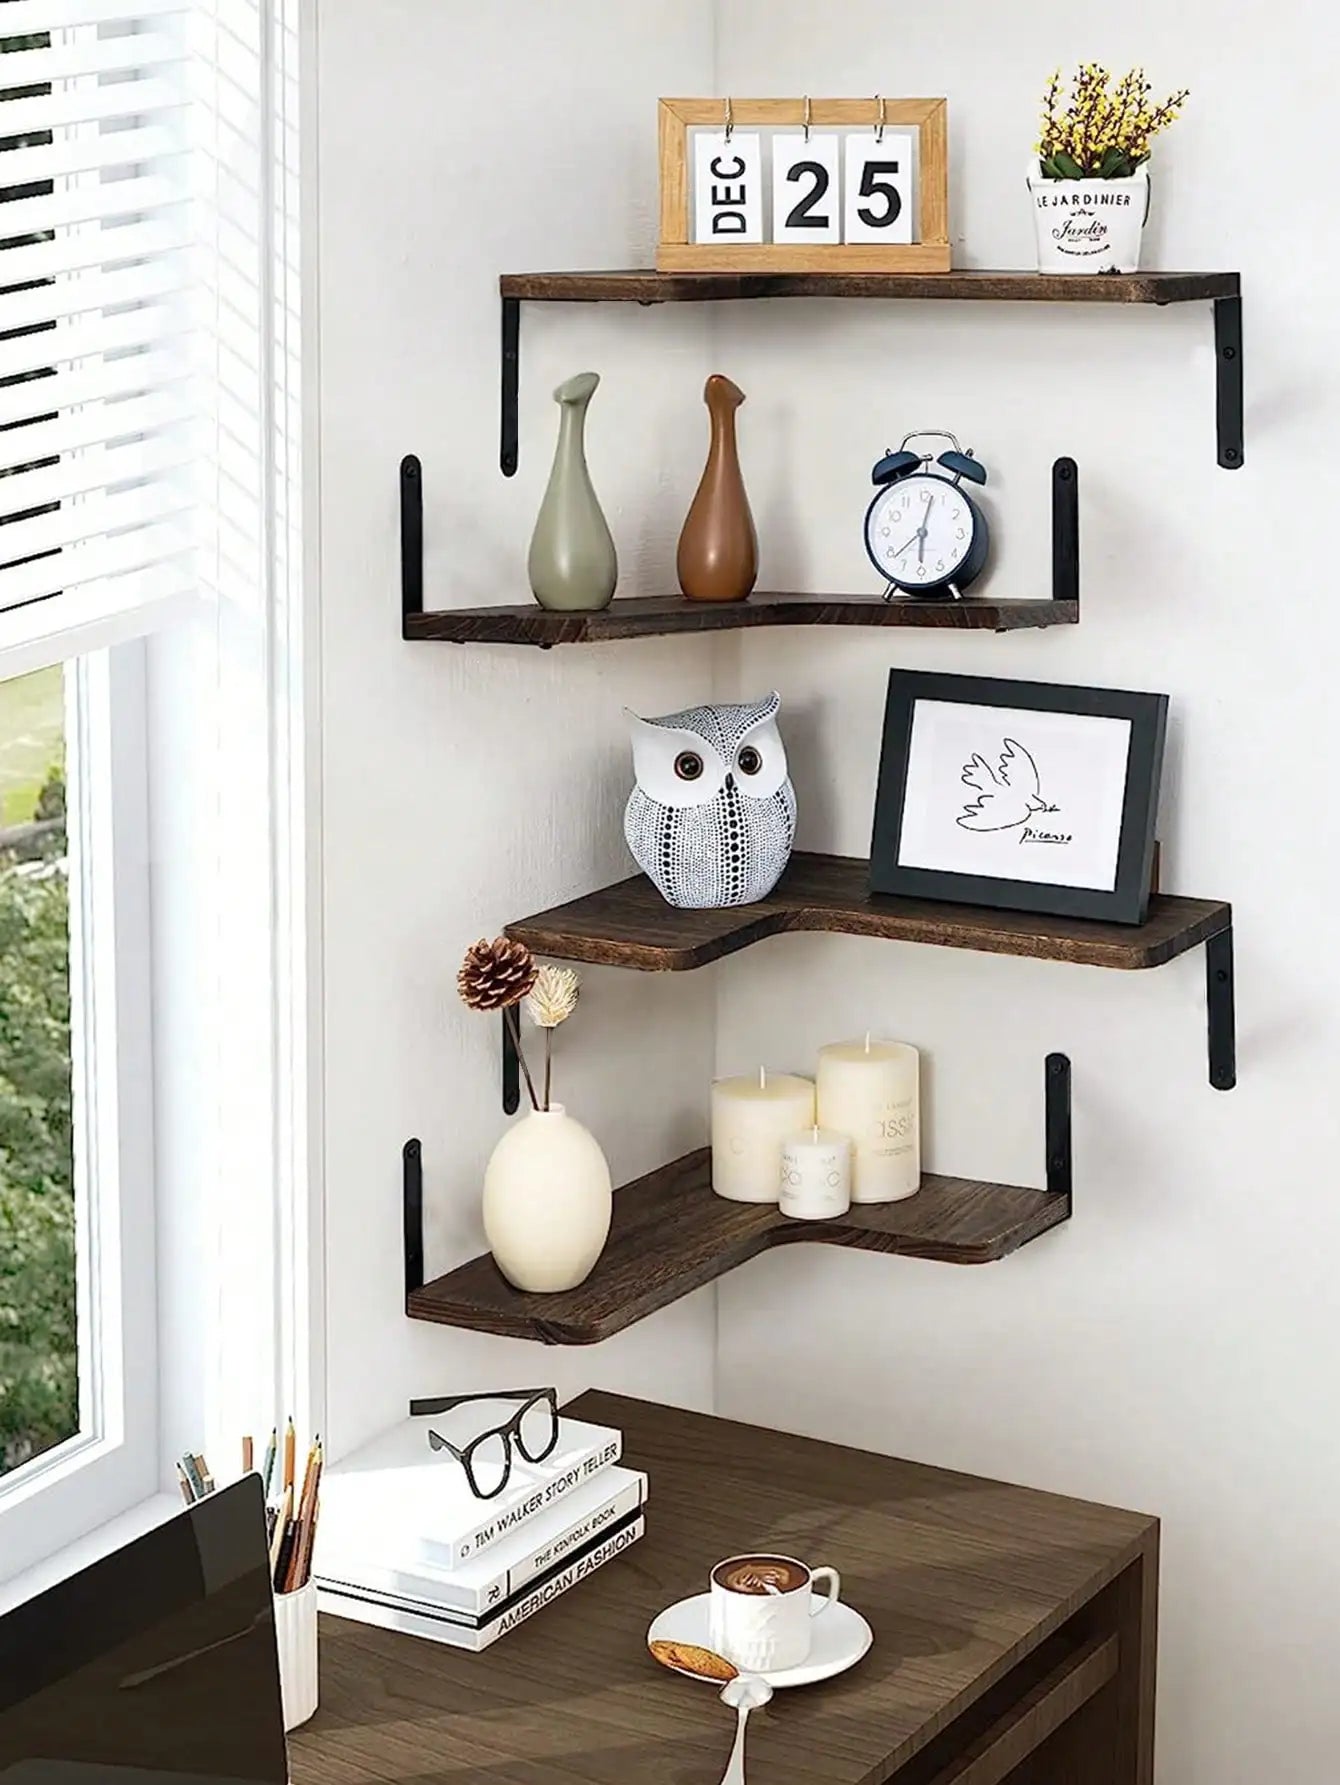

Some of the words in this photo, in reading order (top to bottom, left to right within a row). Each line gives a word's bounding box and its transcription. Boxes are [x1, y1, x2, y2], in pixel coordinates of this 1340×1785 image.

[710, 156, 747, 234] DEC
[1037, 195, 1048, 208] LE
[1052, 194, 1131, 207] JARDINIER
[1052, 220, 1108, 240] Jardin
[474, 1527, 495, 1549] TIM
[497, 1494, 544, 1532] WALKER
[545, 1468, 581, 1501] STORY
[583, 1443, 618, 1475] TELLER
[534, 1548, 552, 1568] THE
[553, 1522, 591, 1556] KINFOLK
[592, 1505, 617, 1529] BOOK
[497, 1569, 573, 1635] AMERICAN
[576, 1526, 637, 1578] FASHION
